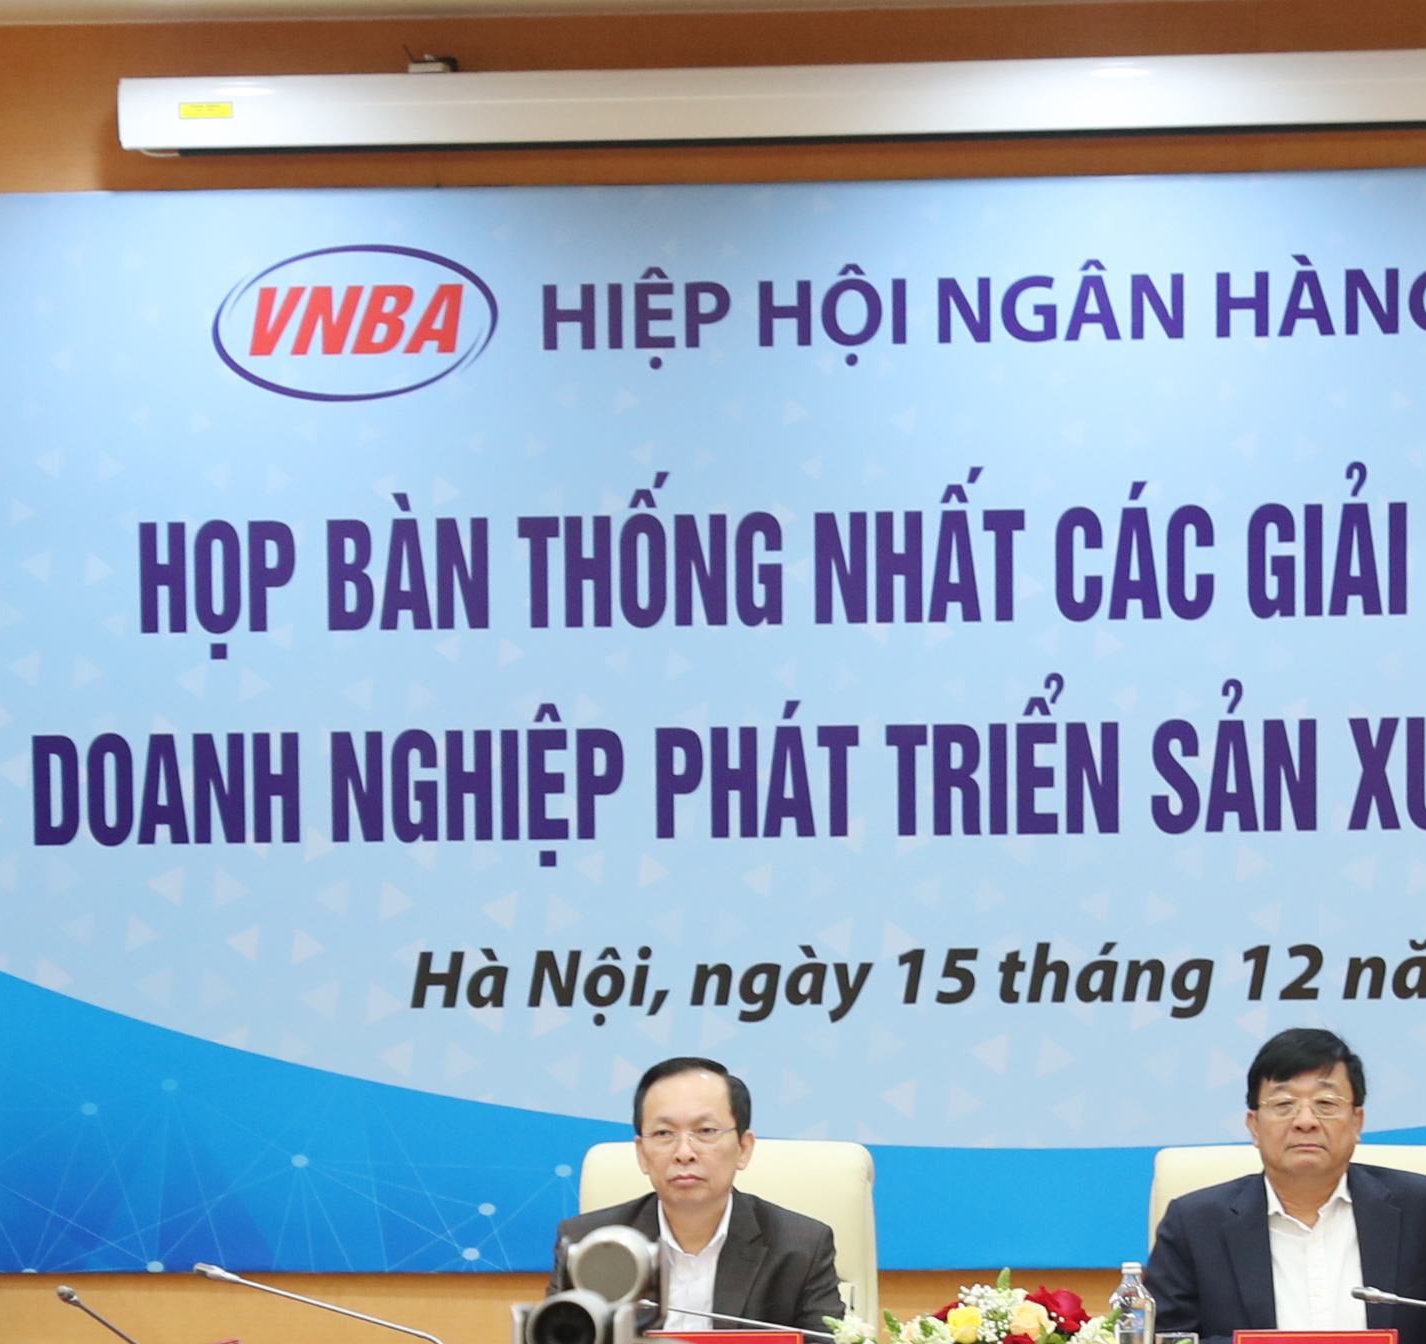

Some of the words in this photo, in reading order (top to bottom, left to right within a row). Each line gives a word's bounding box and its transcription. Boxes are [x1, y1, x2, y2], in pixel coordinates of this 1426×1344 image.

[250, 284, 464, 357] VNBA
[542, 265, 732, 371] HIỆP
[757, 263, 907, 367] HỘI
[937, 259, 1185, 344] NGÂN
[138, 519, 296, 661] HỌP
[326, 492, 490, 632] BÀN
[517, 470, 783, 629] THỐNG
[813, 466, 1026, 625] NHẤT
[1055, 480, 1215, 623] CÁC
[1247, 461, 1408, 620] GIẢI
[31, 731, 301, 848] DOANH
[330, 702, 625, 868] NGHIỆP
[655, 699, 860, 840] PHÁT
[885, 672, 1120, 837] TRIỂN
[1150, 678, 1318, 835] SẢN
[410, 947, 509, 1009] Hà
[527, 945, 670, 1027] Nội,
[689, 944, 874, 1024] ngày
[898, 947, 979, 1005] 15
[998, 941, 1215, 1020] tháng
[1242, 943, 1324, 1001] 12
